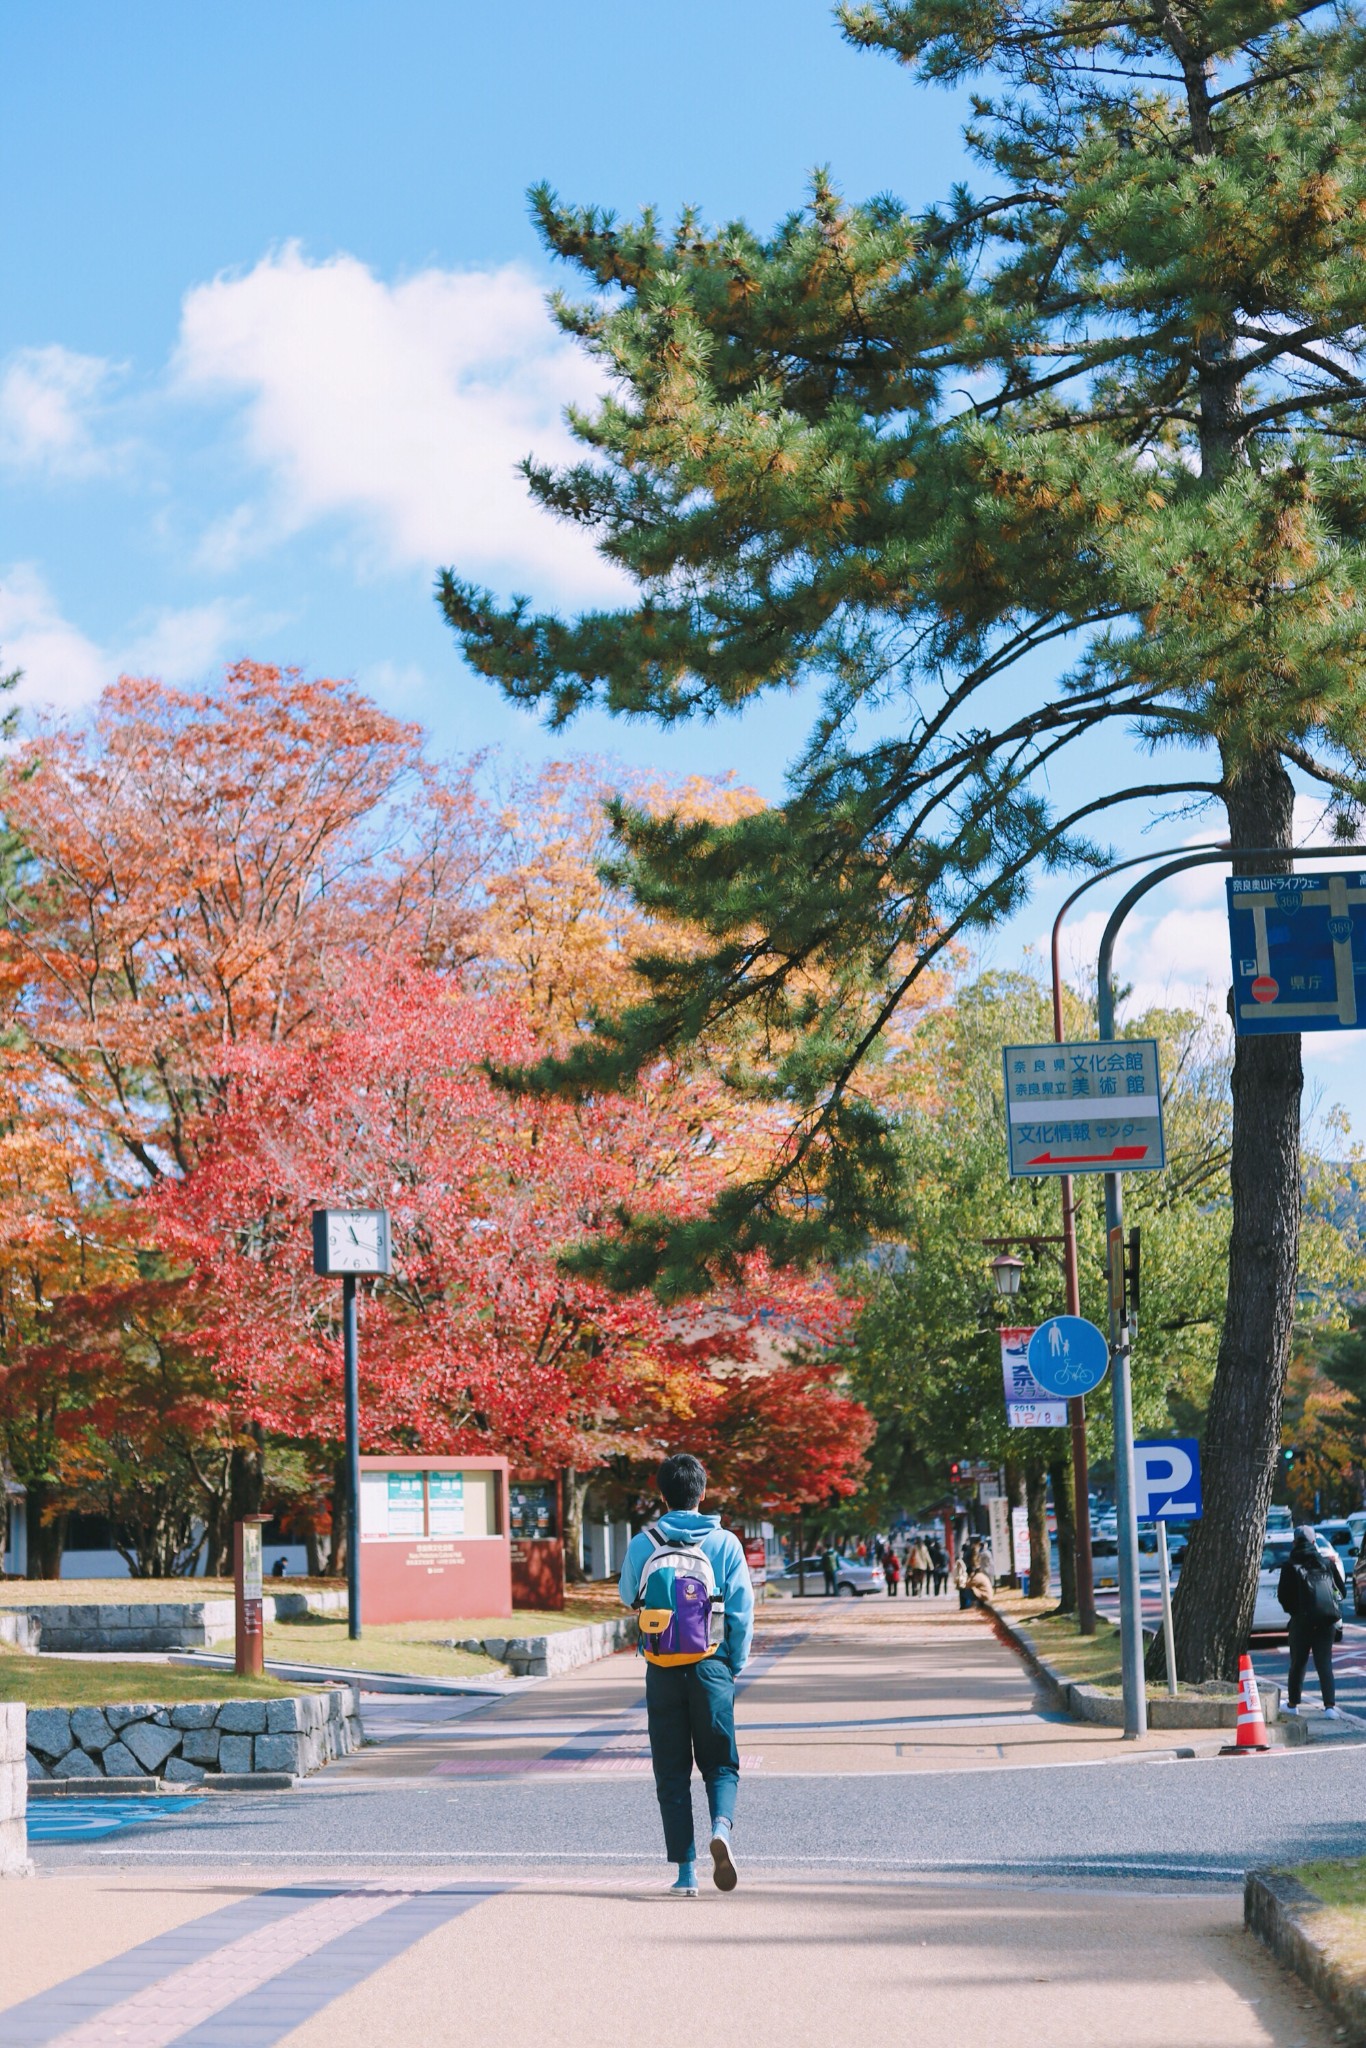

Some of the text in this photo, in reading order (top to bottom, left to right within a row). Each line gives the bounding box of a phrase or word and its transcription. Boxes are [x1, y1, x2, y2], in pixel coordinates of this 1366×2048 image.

[1331, 921, 1351, 935] 369
[1242, 960, 1255, 974] P
[1291, 975, 1322, 990] 県庁
[351, 1213, 360, 1223] 12
[329, 1236, 336, 1246] 9
[377, 1237, 382, 1246] 3
[353, 1260, 360, 1269] 6
[1014, 1404, 1036, 1412] 2019
[1135, 1445, 1193, 1516] P
